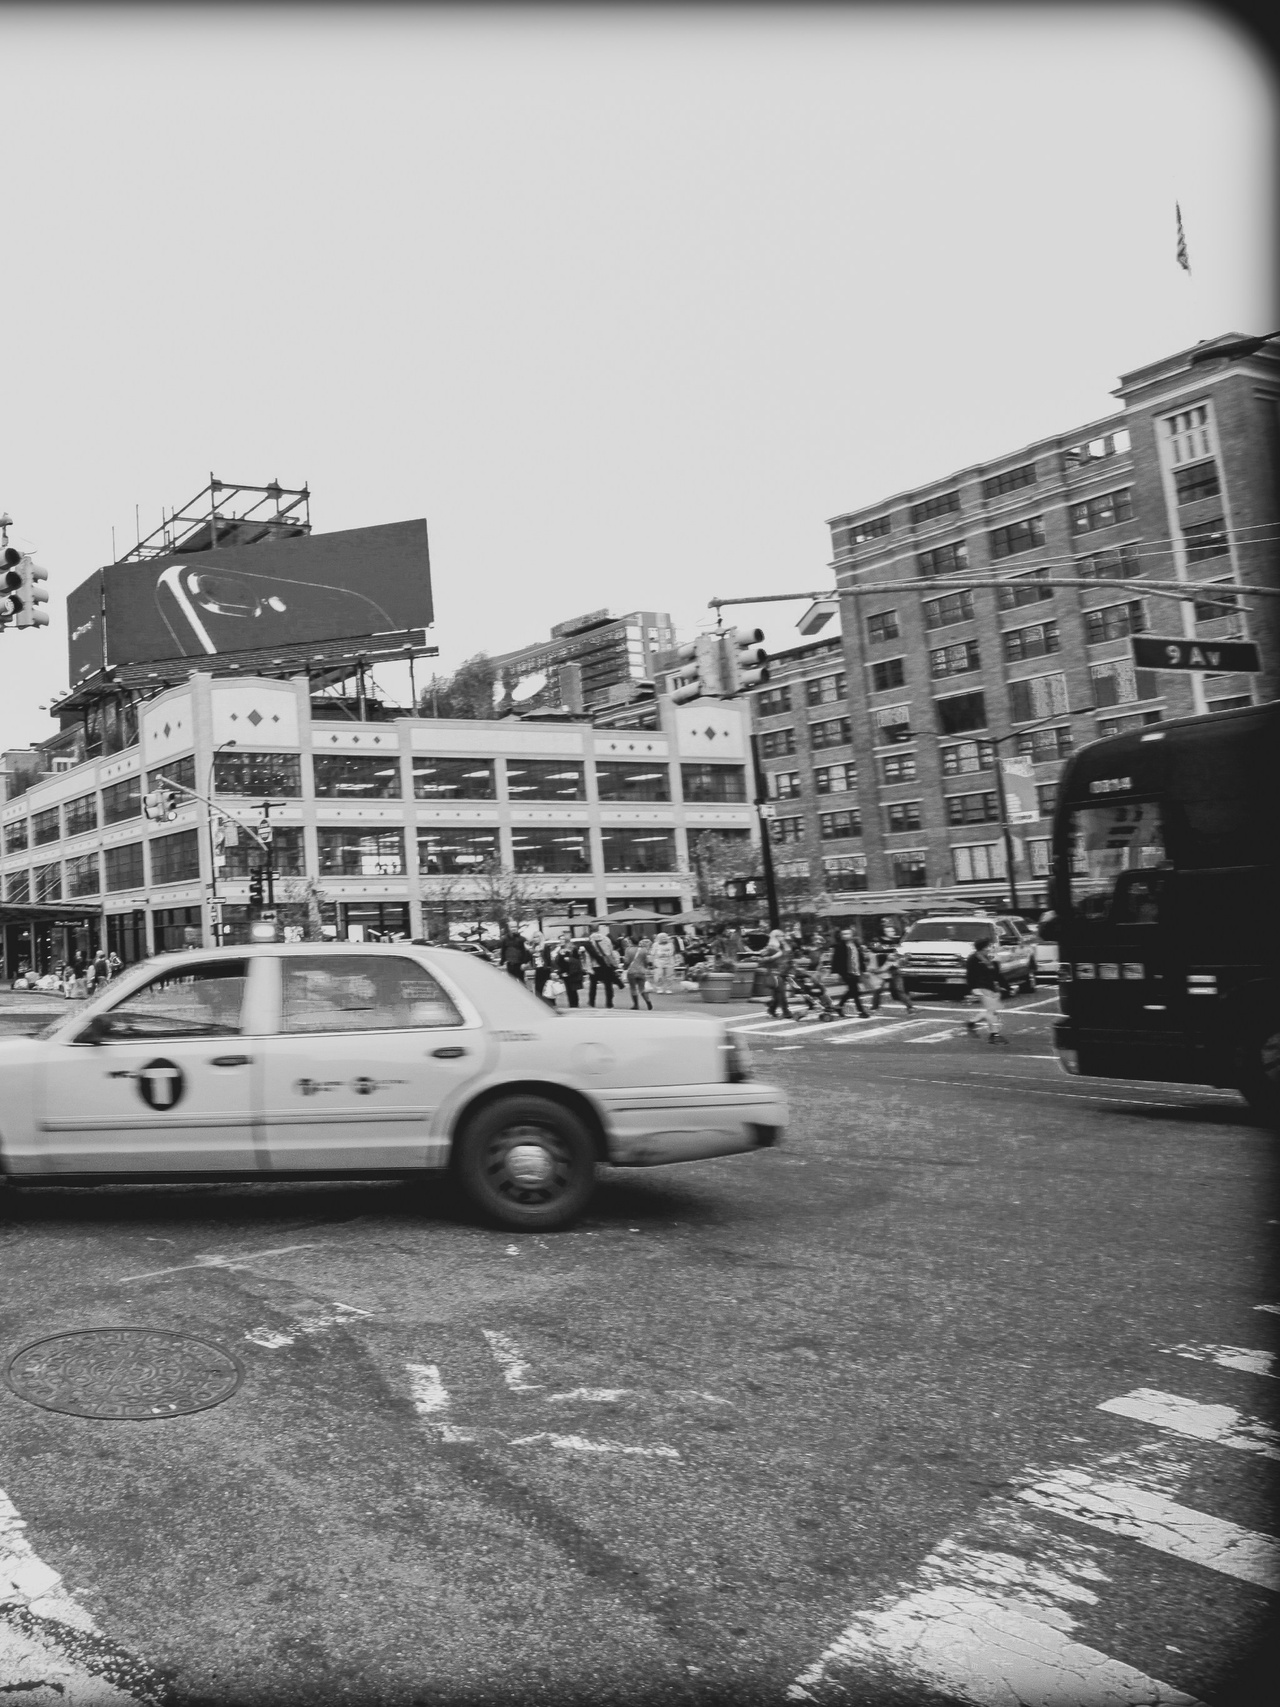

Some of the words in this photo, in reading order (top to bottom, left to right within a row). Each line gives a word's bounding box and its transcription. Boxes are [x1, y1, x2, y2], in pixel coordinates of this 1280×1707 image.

[1165, 645, 1181, 665] 9
[1188, 646, 1221, 666] Av
[141, 1067, 179, 1105] T
